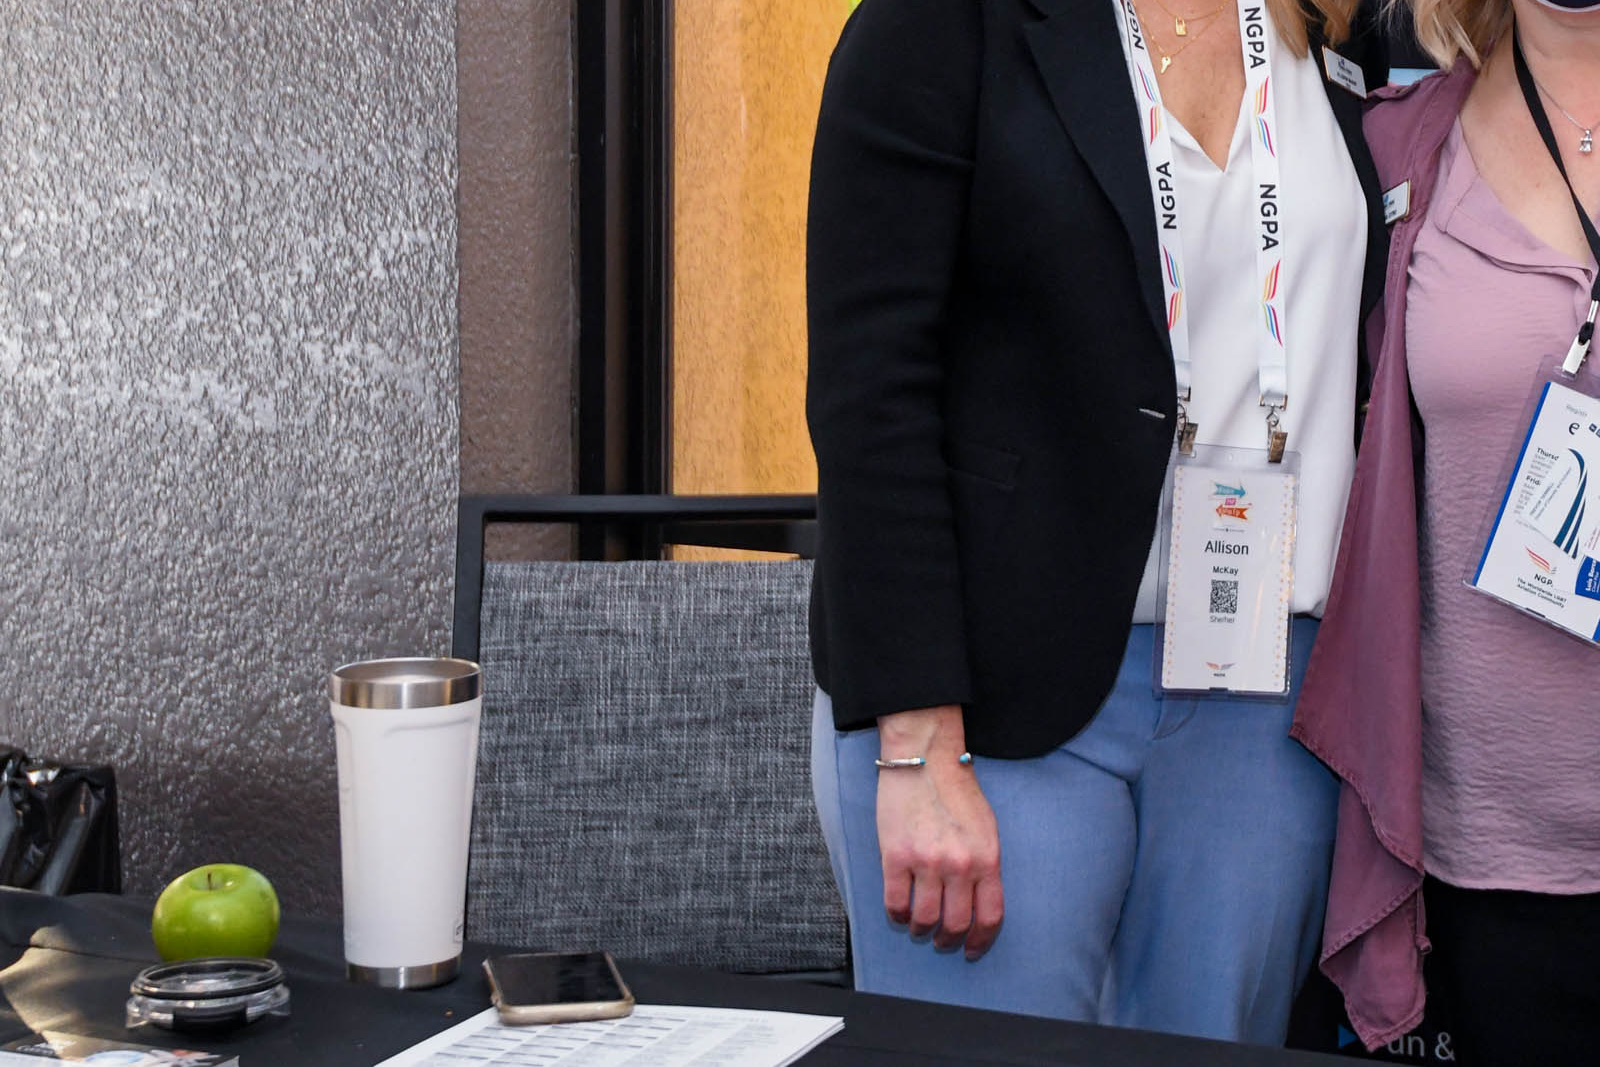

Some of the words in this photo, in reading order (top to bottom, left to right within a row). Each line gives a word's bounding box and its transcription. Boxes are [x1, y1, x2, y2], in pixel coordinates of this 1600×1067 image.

[1126, 0, 1145, 50] NGP
[1244, 6, 1267, 69] NGPA
[1156, 161, 1177, 230] NGPA
[1259, 183, 1279, 252] NGPA
[1204, 540, 1249, 555] Allison
[1212, 566, 1239, 576] McKay
[1534, 574, 1553, 587] NGP
